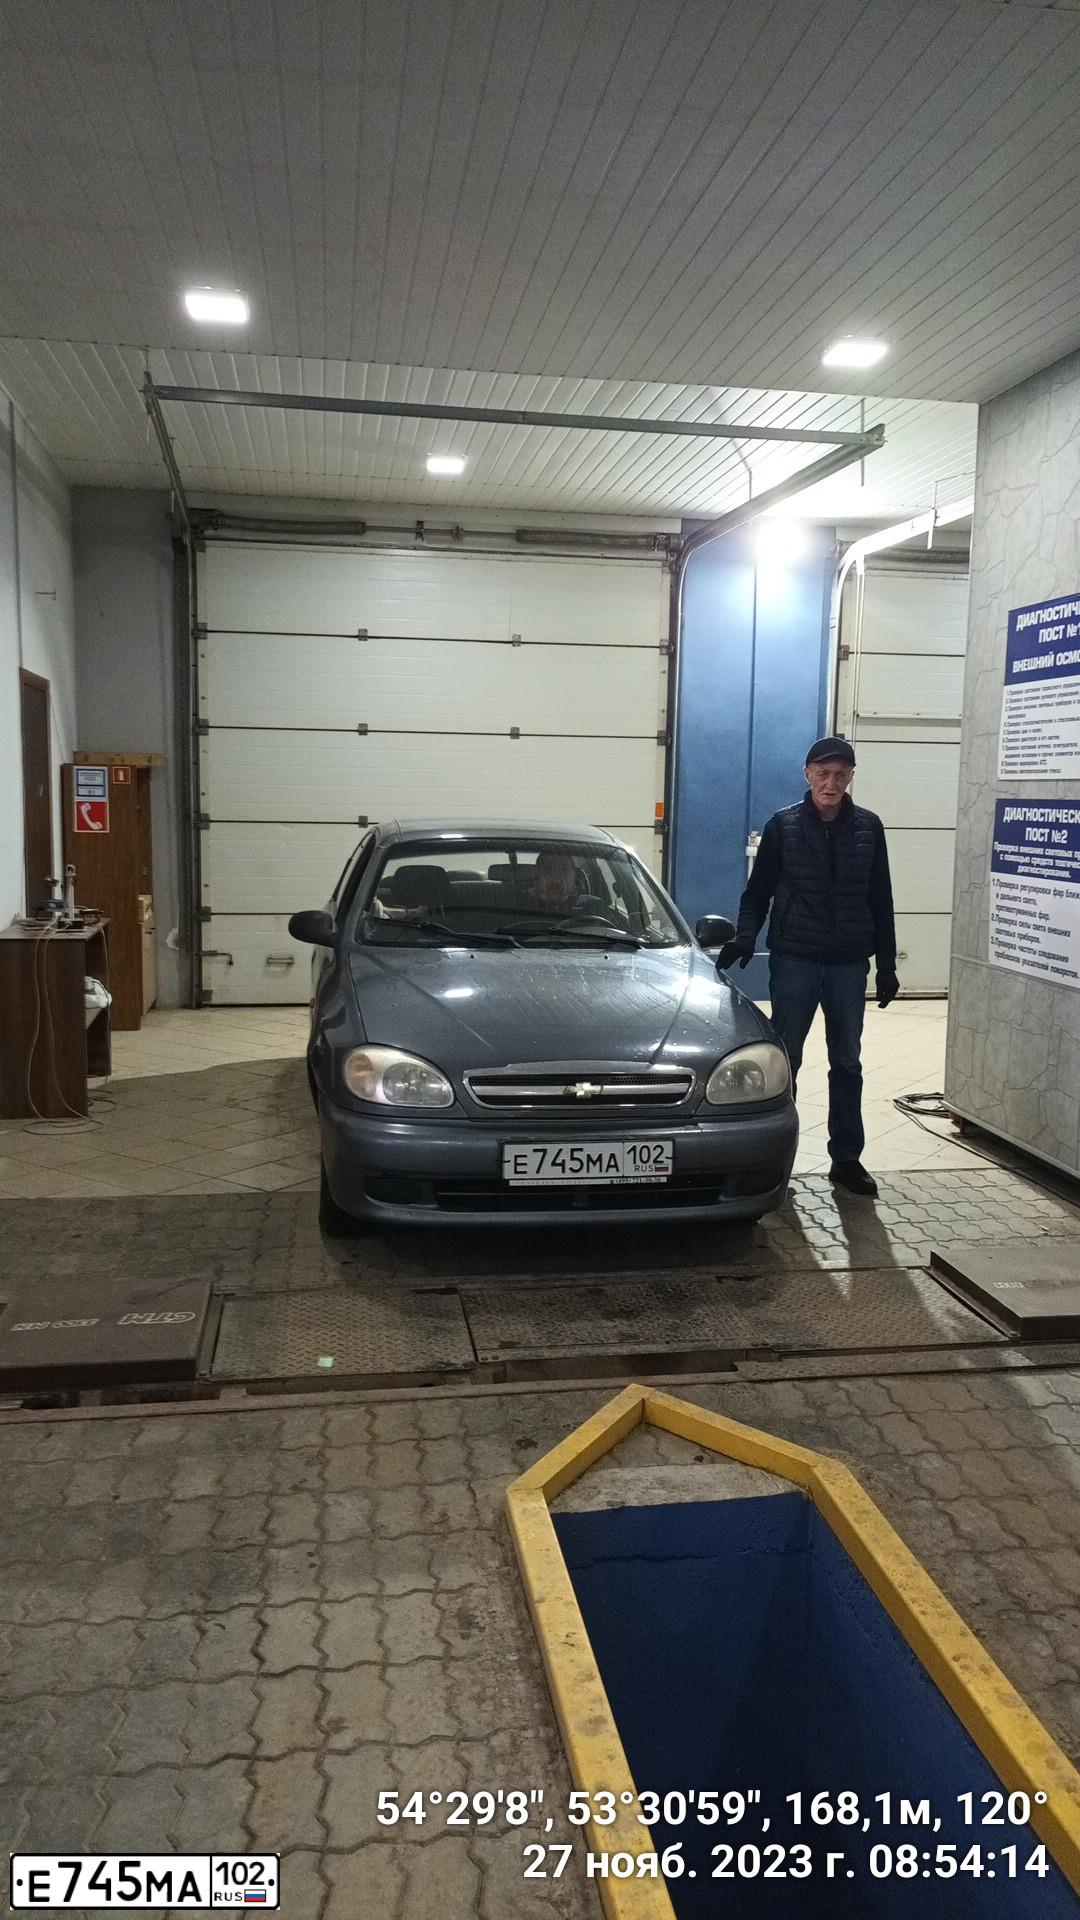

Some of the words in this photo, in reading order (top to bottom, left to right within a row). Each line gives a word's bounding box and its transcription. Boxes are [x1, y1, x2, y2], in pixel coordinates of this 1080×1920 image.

[1038, 625, 1065, 643] ПОСТ
[1012, 651, 1055, 673] ВНЕШНИЙ
[1025, 827, 1050, 843] ПОСТ
[1051, 829, 1068, 844] №2
[1053, 887, 1064, 898] фар
[513, 1148, 620, 1175] Е745МА
[626, 1144, 665, 1165] 102
[634, 1164, 654, 1173] RUS
